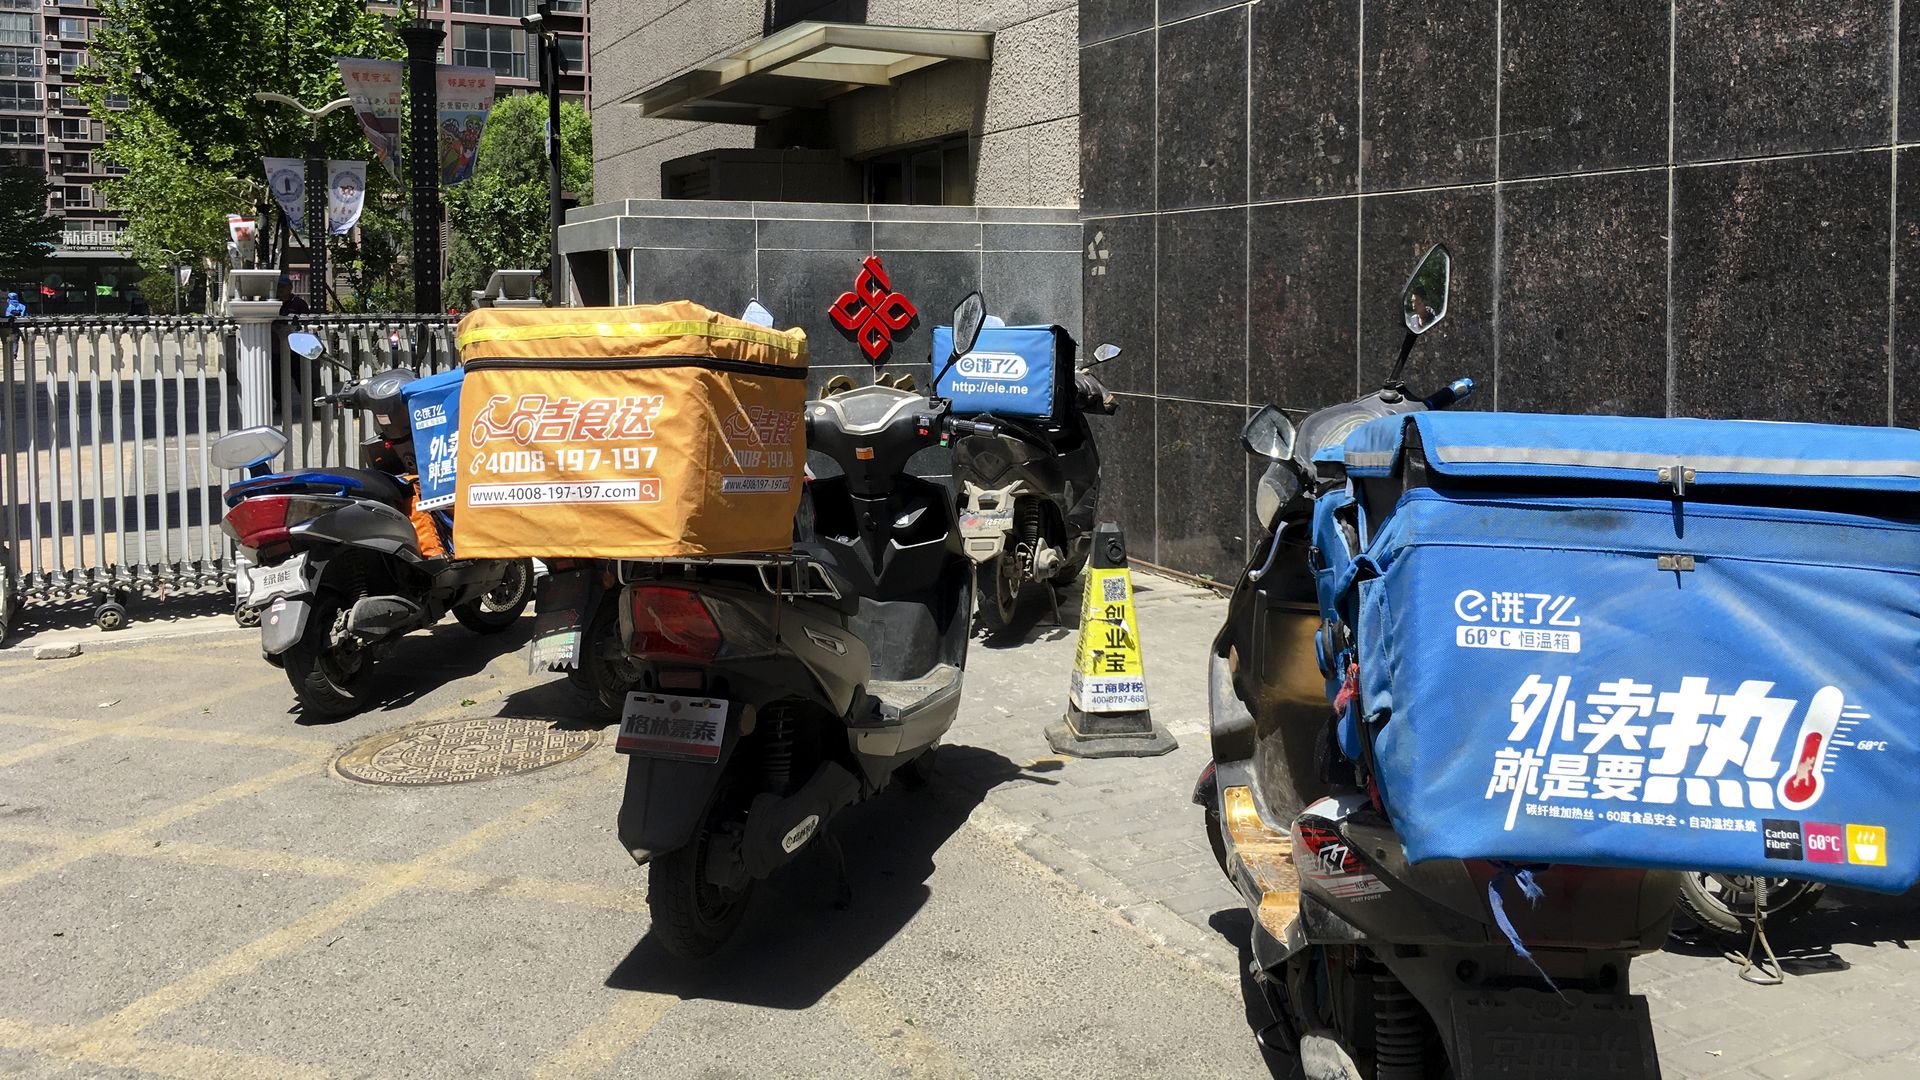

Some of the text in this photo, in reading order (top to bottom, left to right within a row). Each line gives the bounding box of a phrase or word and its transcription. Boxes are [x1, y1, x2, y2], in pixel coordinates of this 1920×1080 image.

[952, 380, 1029, 395] http://ele.me
[485, 447, 659, 475] 4008-197-197
[472, 484, 637, 502] www.4008-197-197.com
[1491, 591, 1580, 627] 饿了么
[1518, 630, 1570, 650] 恒温箱
[1091, 681, 1144, 694] 工商财税
[1526, 803, 1757, 833] 碳纤维加热丝 60度食品安全 自动温控系统
[1765, 828, 1799, 840] Carbon
[1766, 839, 1791, 849] Fiber
[1354, 881, 1369, 890] NEW
